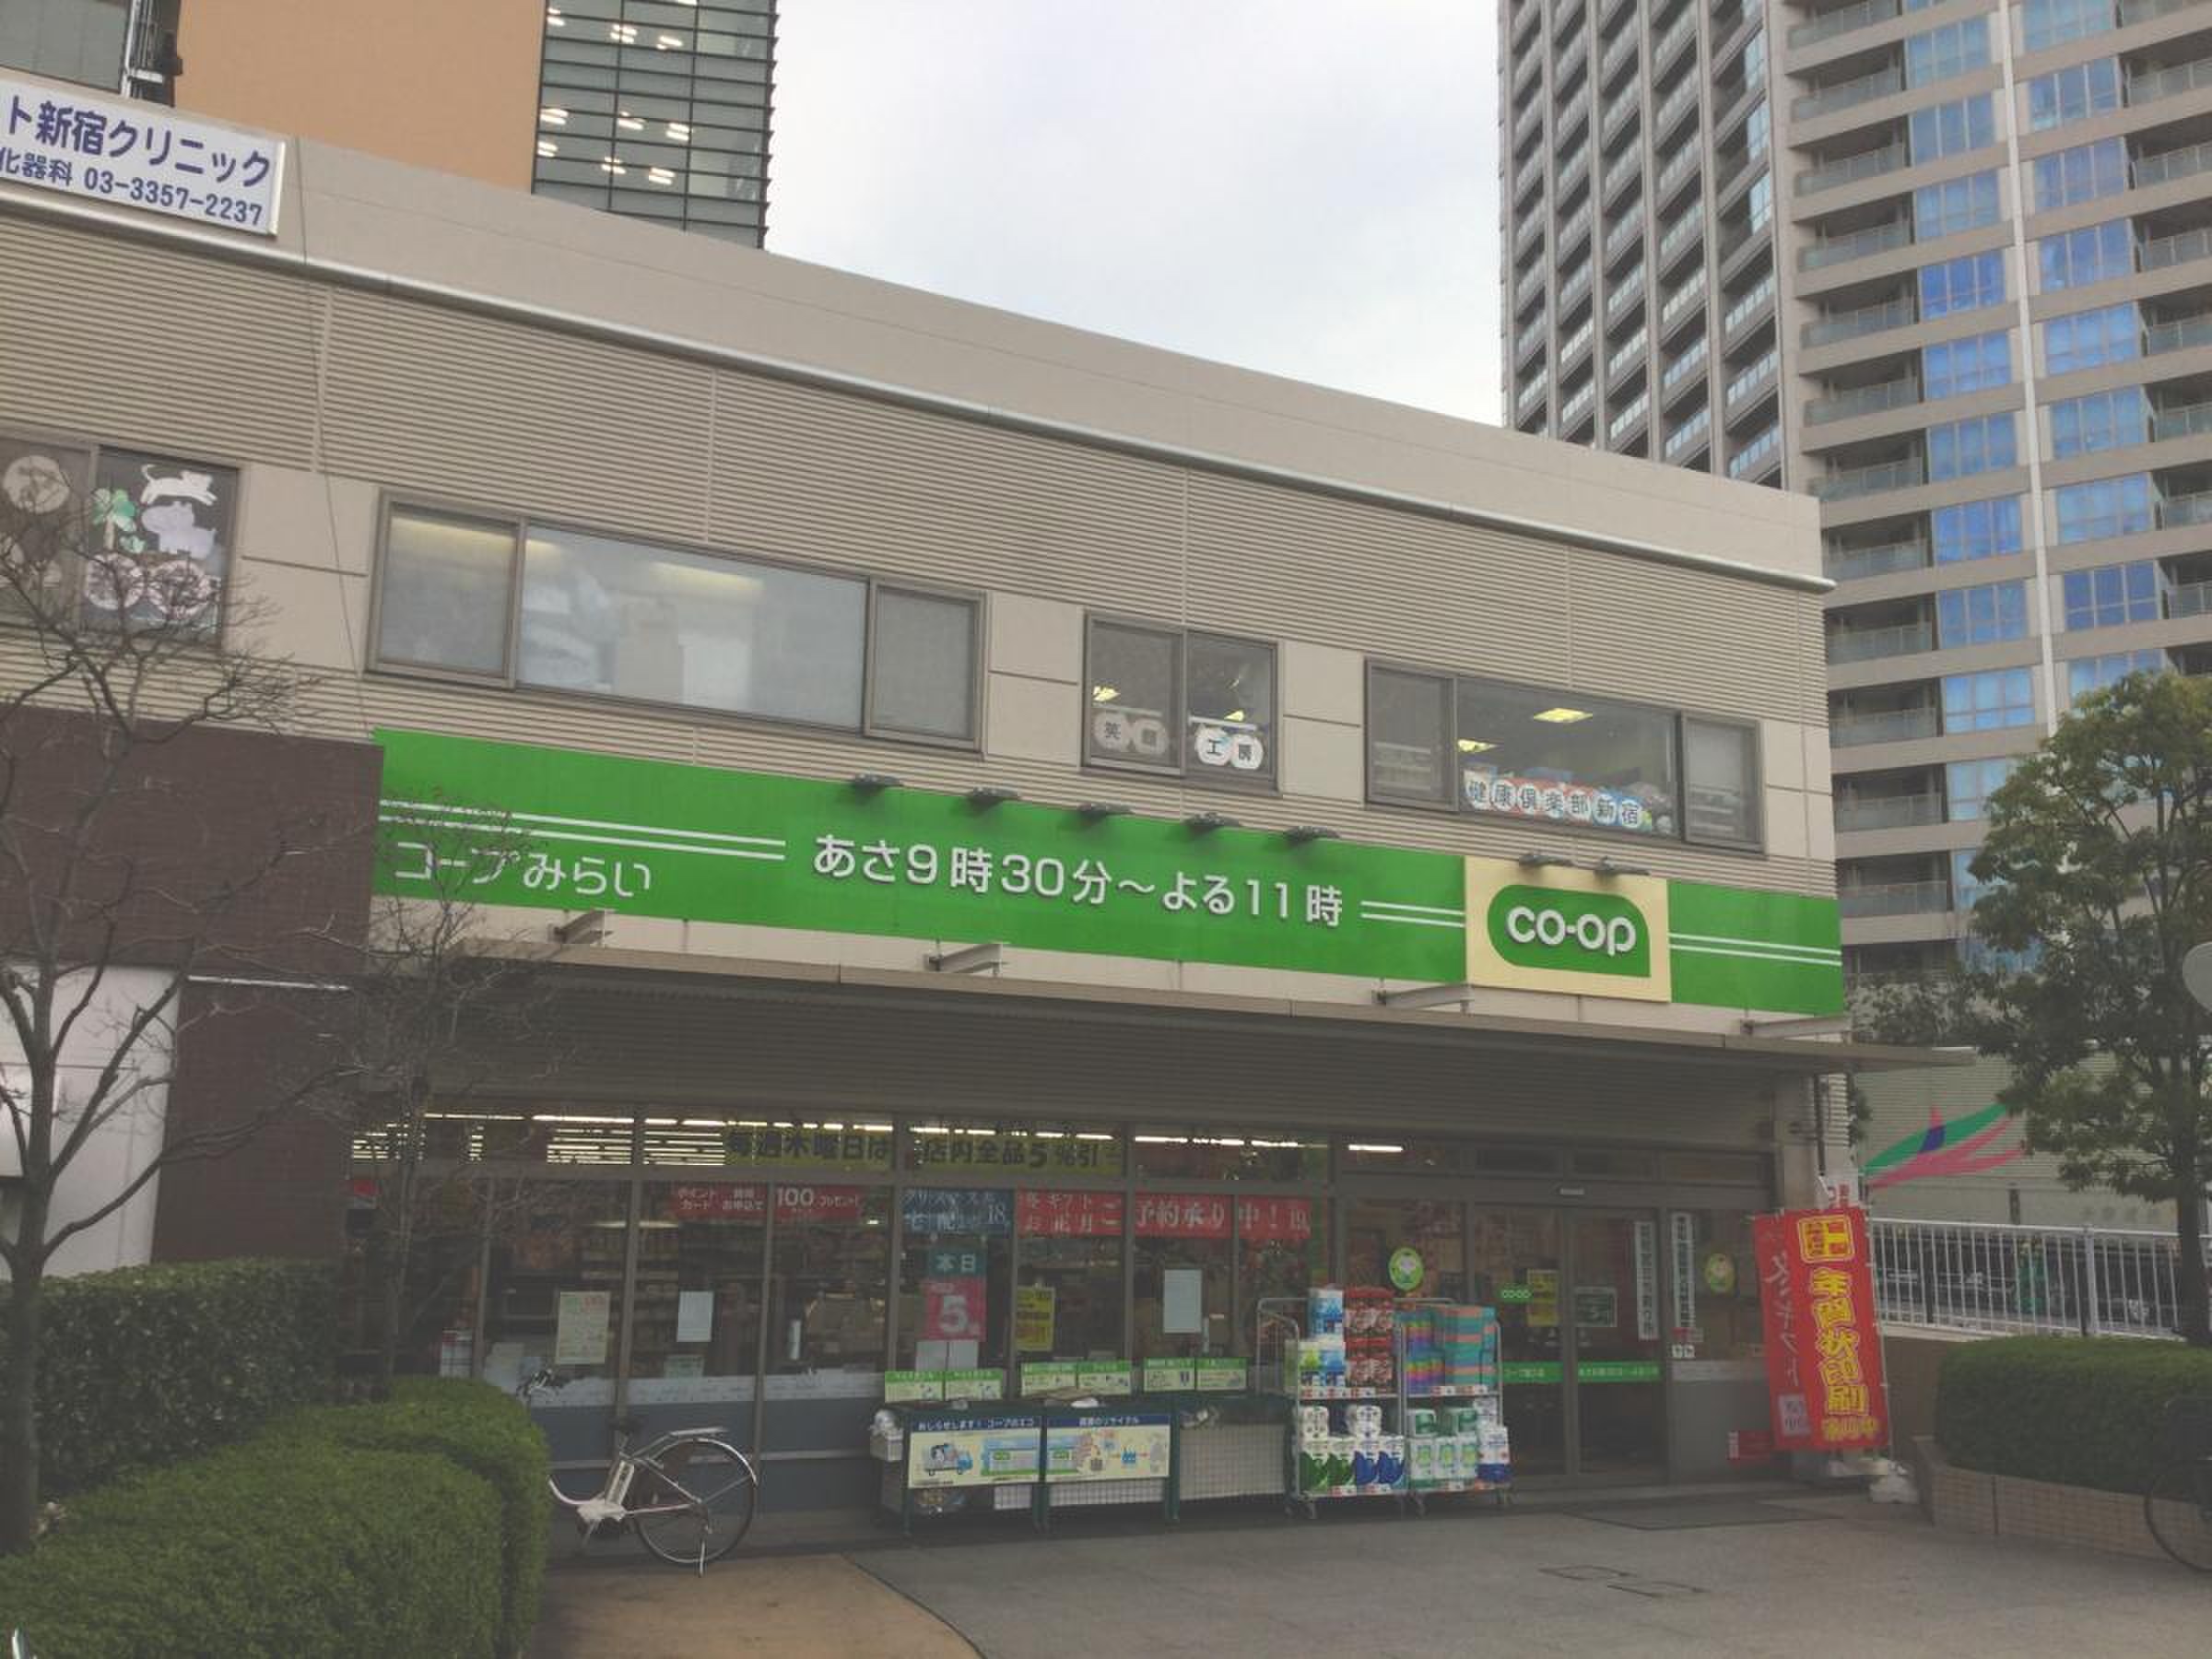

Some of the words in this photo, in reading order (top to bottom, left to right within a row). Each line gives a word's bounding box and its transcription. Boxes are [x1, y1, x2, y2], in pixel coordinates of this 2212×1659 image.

[9, 95, 271, 188] ト新宿クリニック
[84, 165, 264, 227] 03-3357-2237
[394, 841, 653, 899] コープみらい
[776, 1187, 815, 1208] 100
